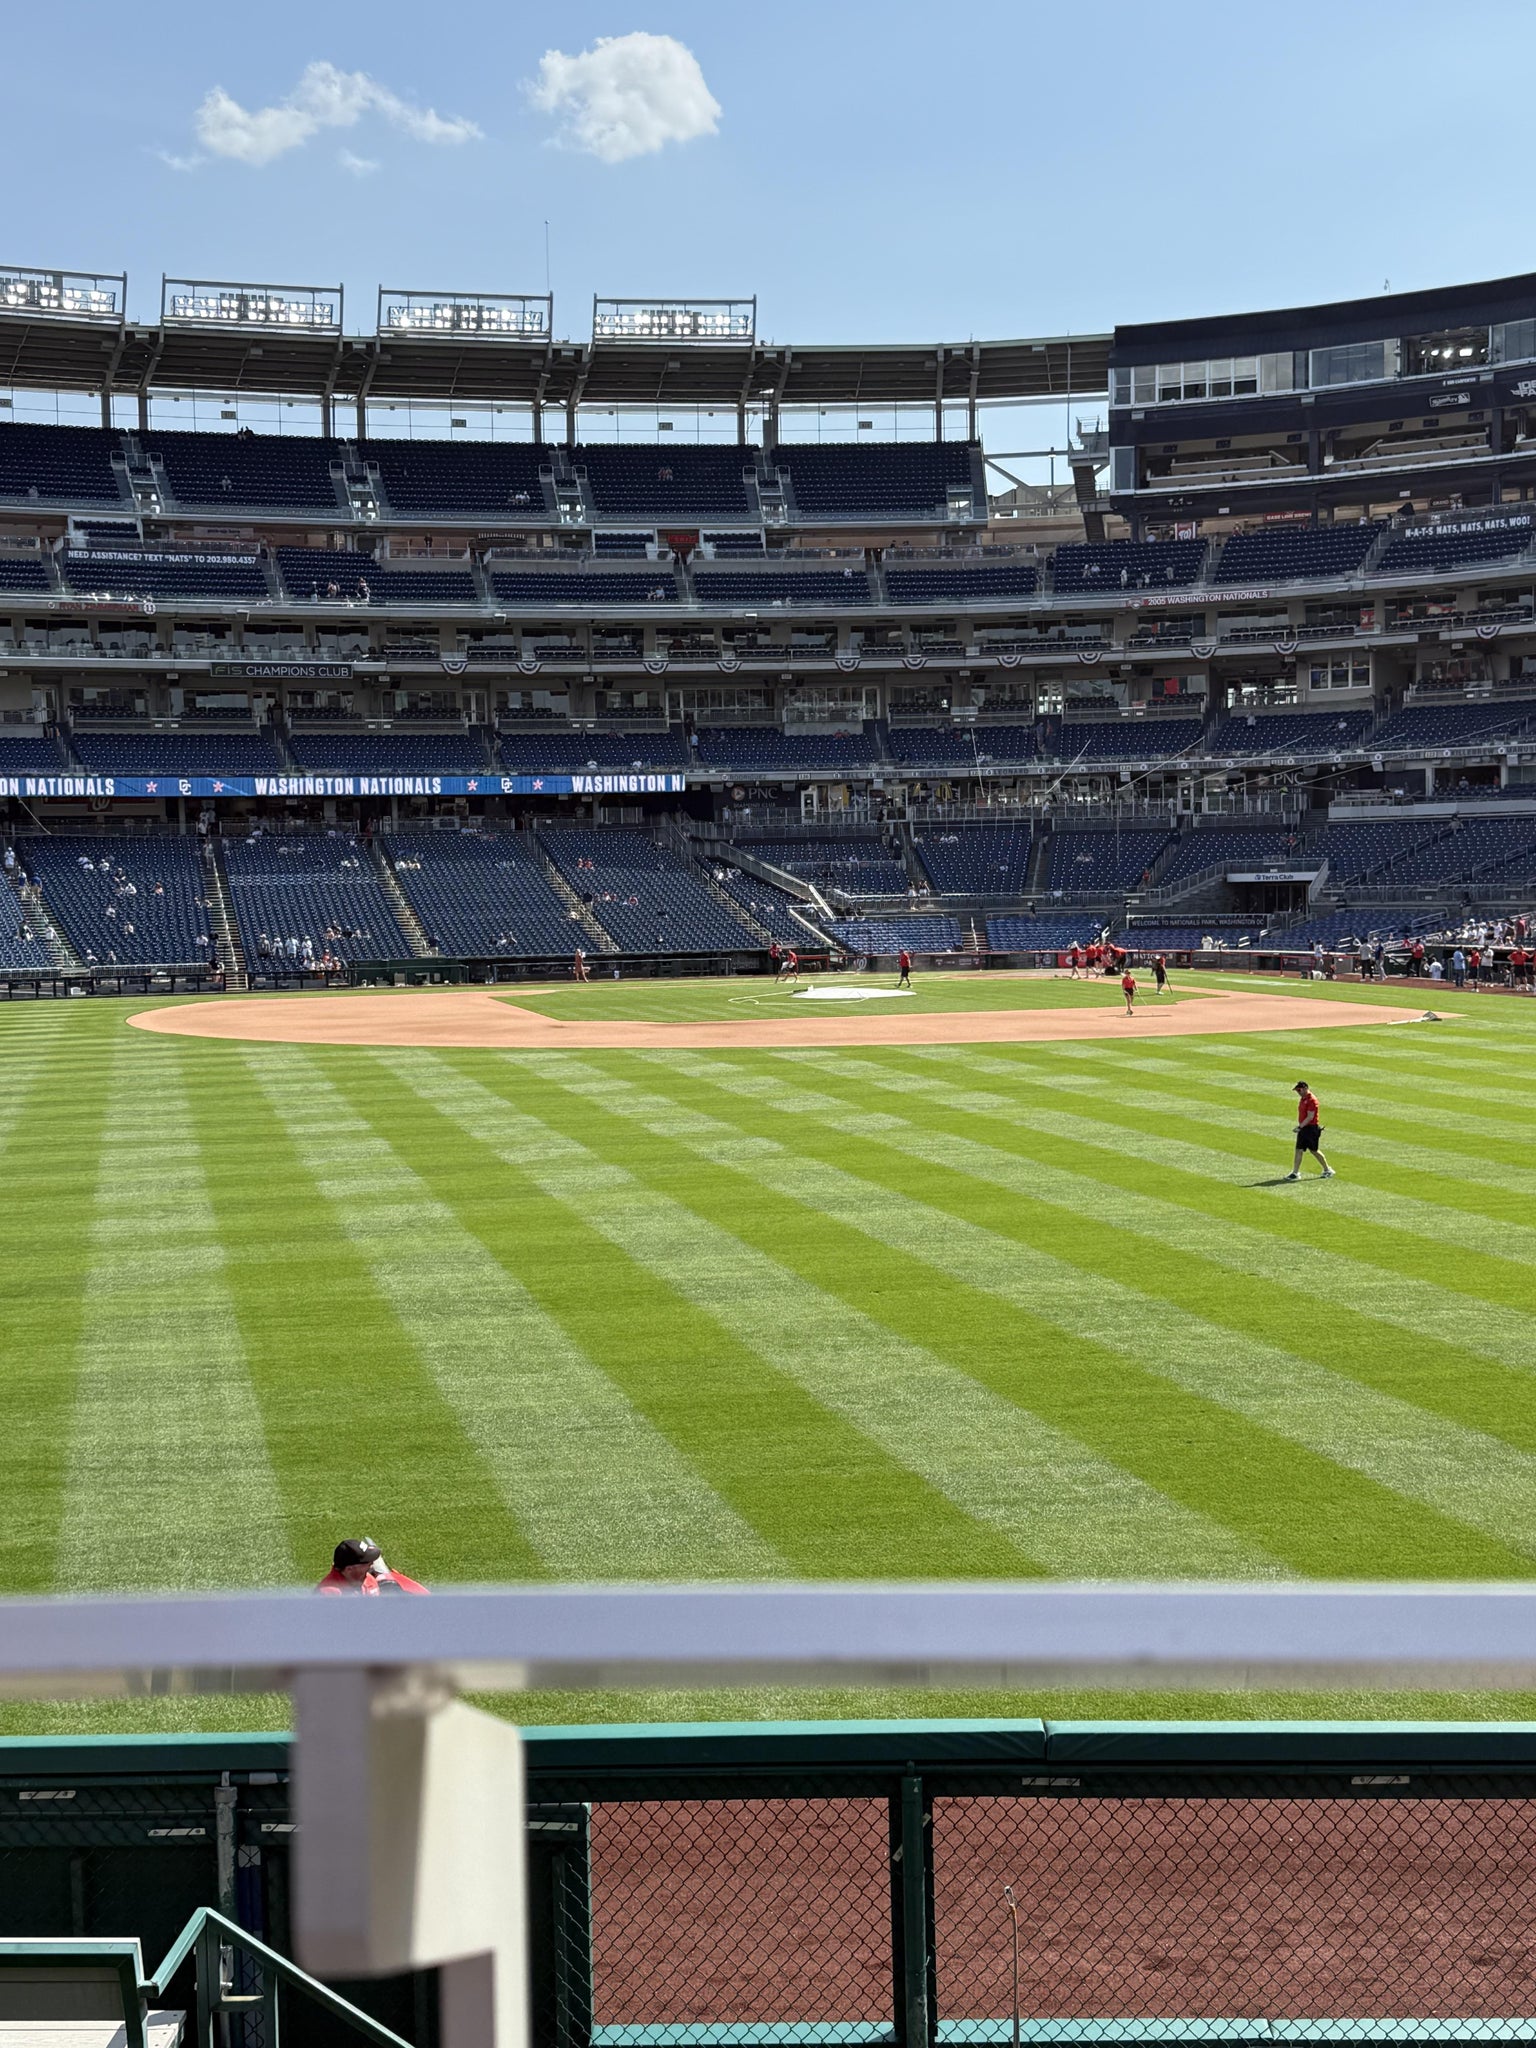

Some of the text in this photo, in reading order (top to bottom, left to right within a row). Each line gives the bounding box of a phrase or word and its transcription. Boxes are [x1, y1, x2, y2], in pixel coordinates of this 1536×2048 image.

[1509, 515, 1531, 527] WOO!
[68, 550, 89, 559] NEED
[91, 551, 143, 561] ASSISTANCE?
[144, 553, 164, 562] TEXT
[1148, 591, 1269, 606] 2005 WASHINGTON NATIONALS
[245, 665, 316, 677] CHAMPIONS
[318, 667, 350, 679] CLUB
[571, 774, 666, 794] WASHINGTON
[1273, 771, 1304, 786] PNC
[26, 777, 115, 797] NATIONALS
[254, 776, 442, 796] WASHINGTON NATIONALS
[748, 787, 778, 800] PNC
[1132, 918, 1162, 927] WELCOME
